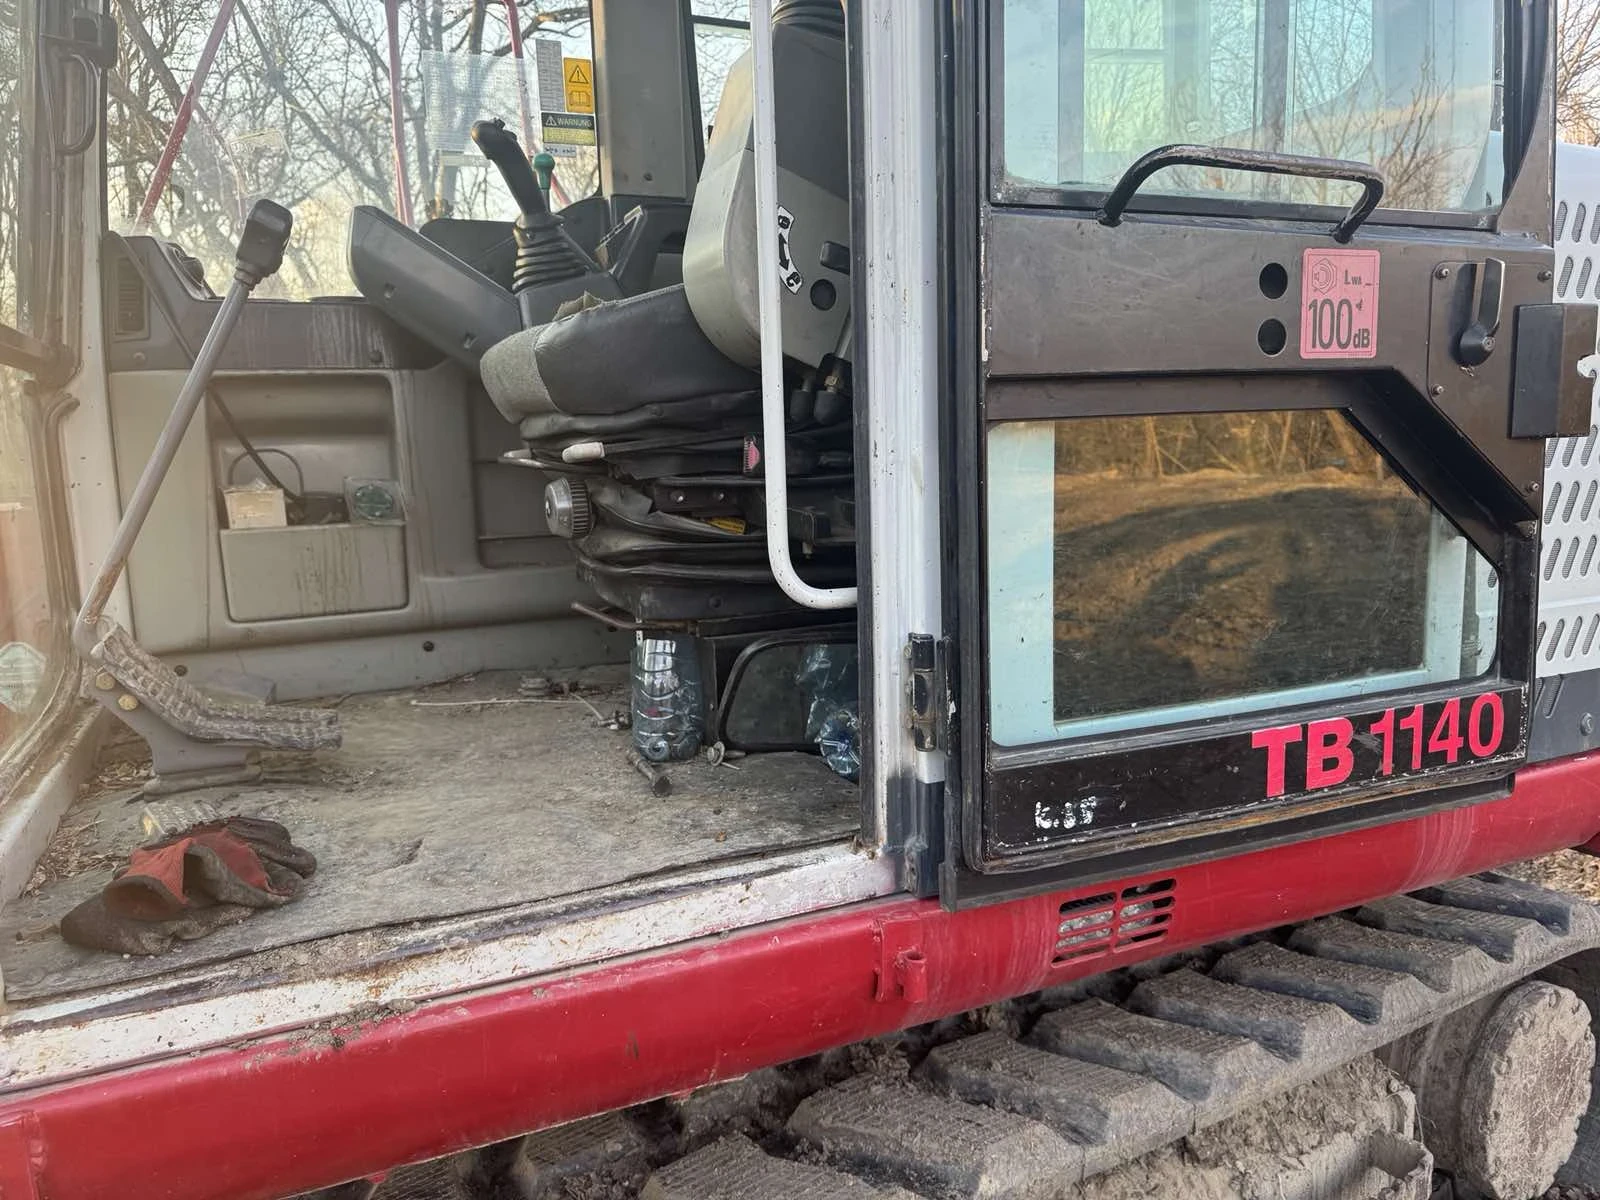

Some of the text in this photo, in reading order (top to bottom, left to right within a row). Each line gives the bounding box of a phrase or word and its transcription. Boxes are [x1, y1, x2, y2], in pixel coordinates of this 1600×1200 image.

[1308, 298, 1353, 350] 100
[1251, 691, 1505, 797] TB 1140
